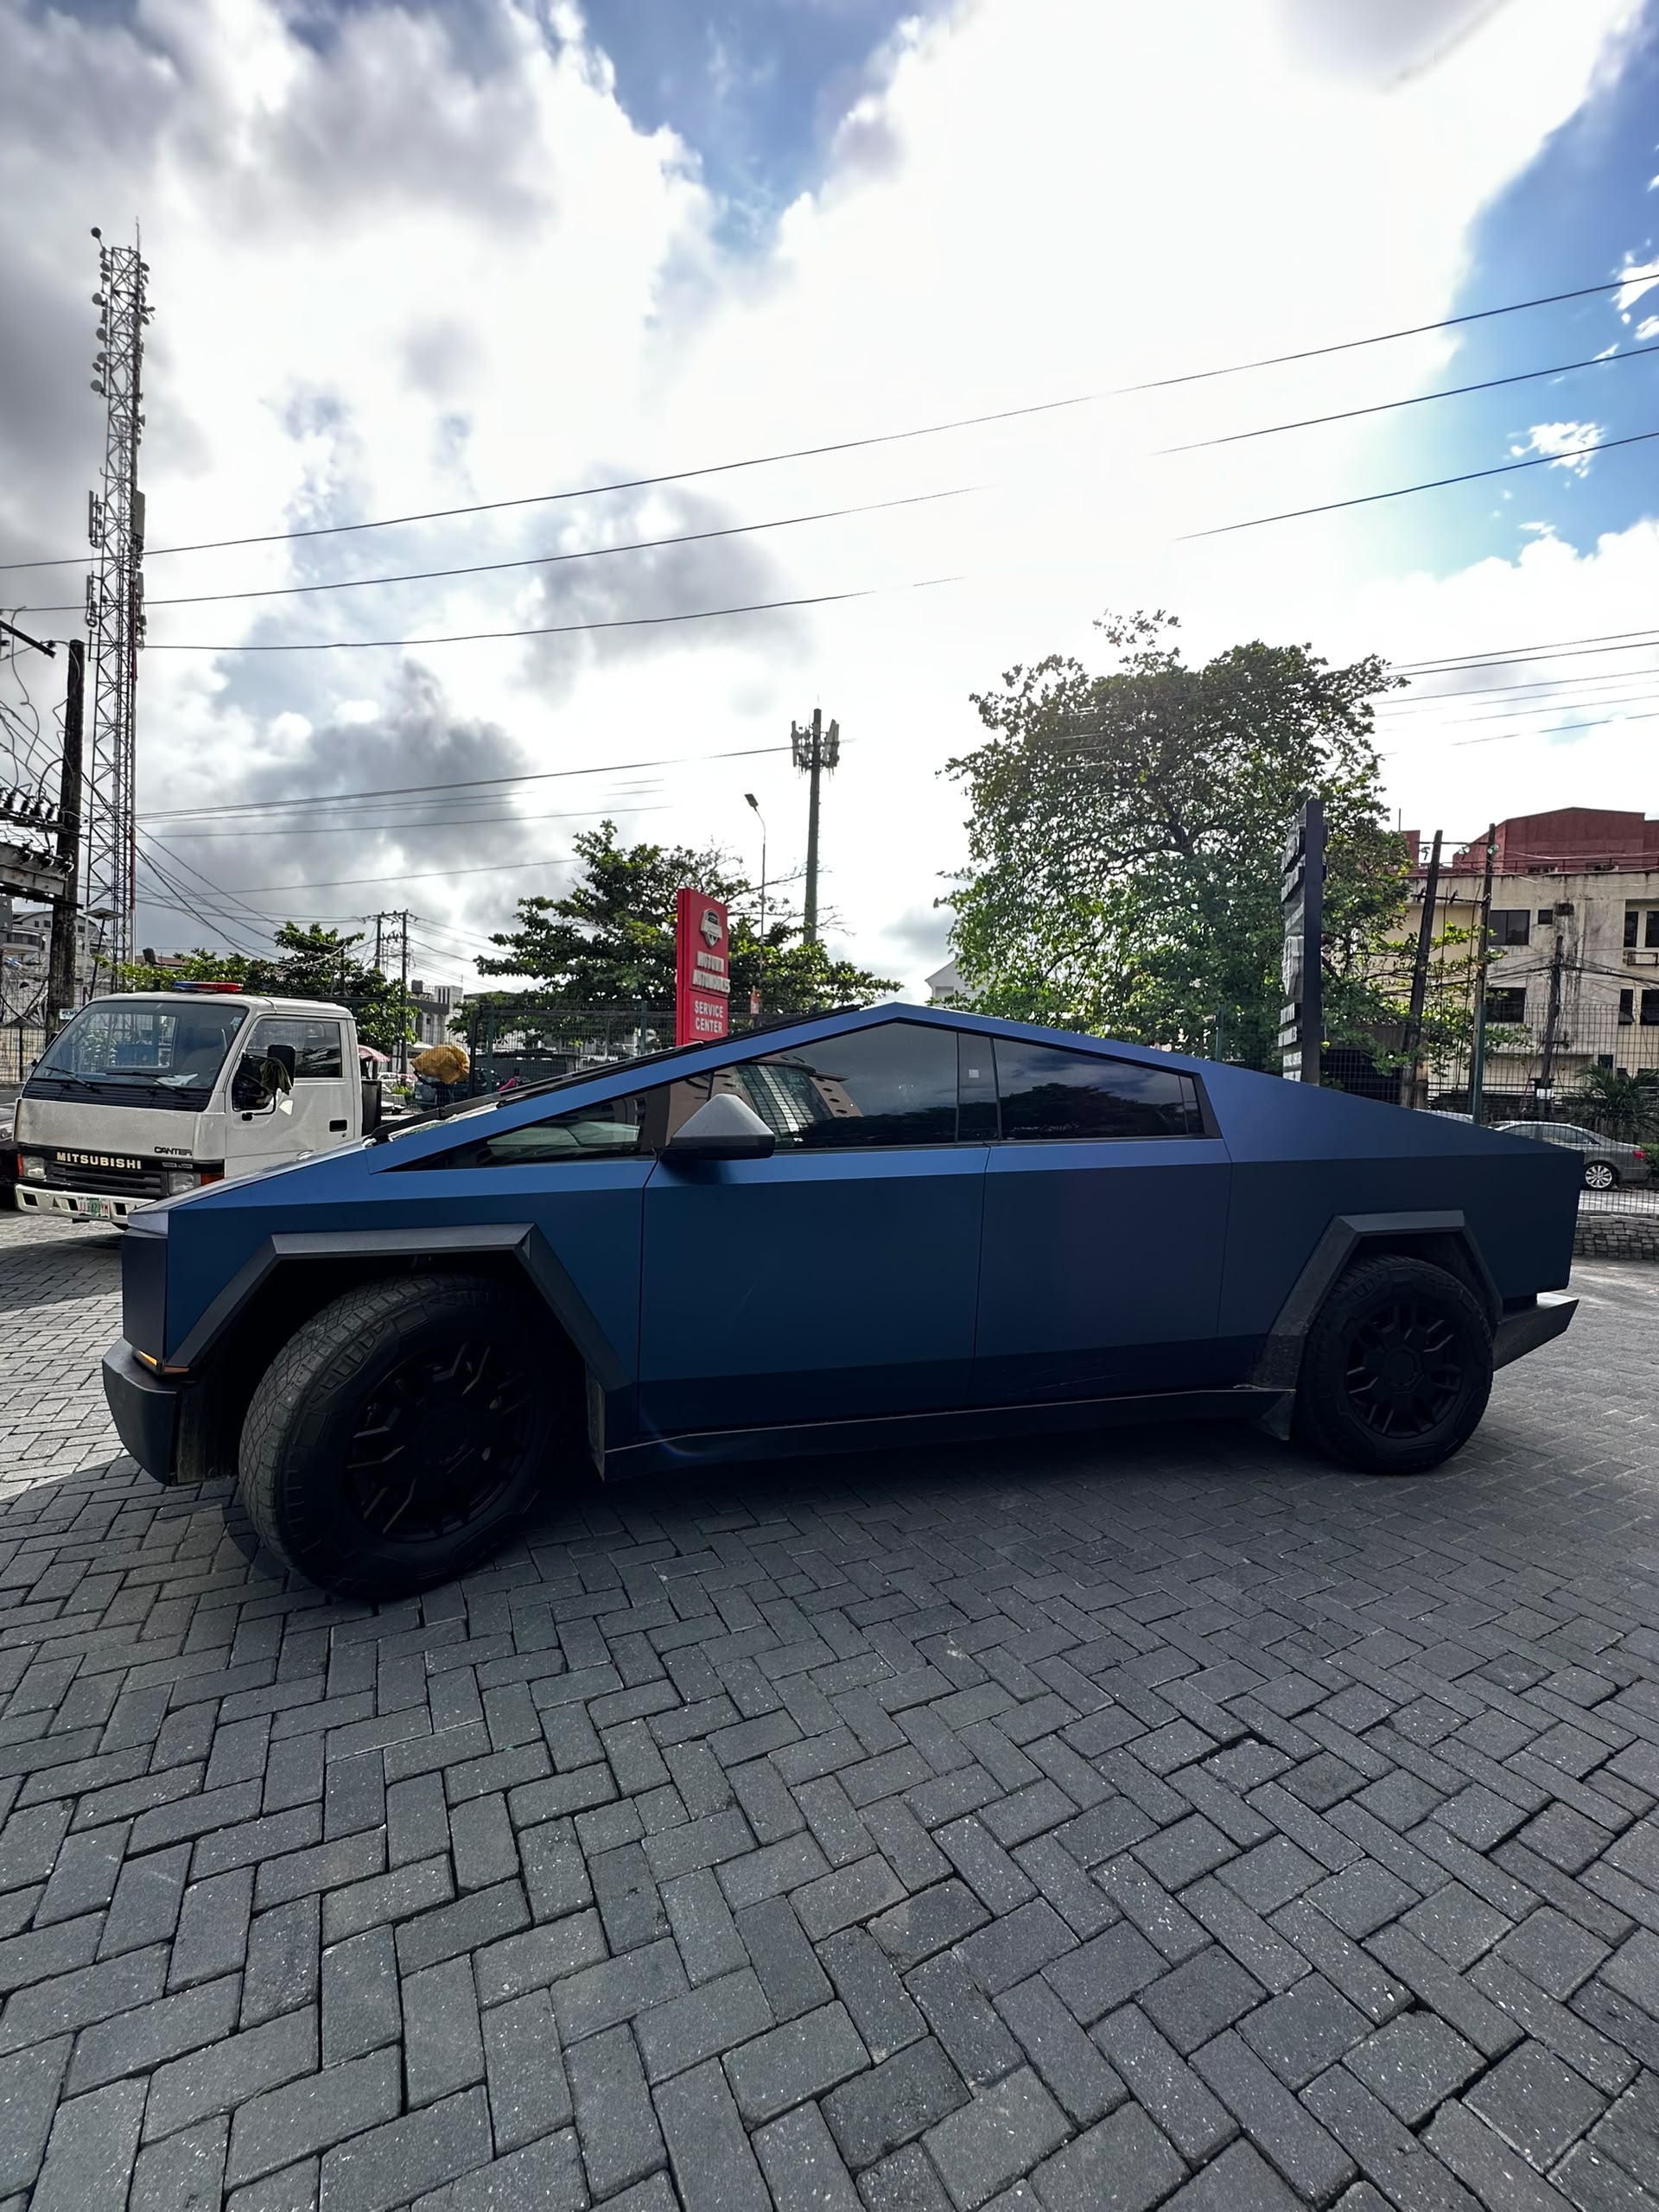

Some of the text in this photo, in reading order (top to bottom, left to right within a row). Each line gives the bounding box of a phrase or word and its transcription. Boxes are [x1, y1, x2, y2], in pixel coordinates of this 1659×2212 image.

[694, 1000, 723, 1018] SERVICE
[695, 1017, 722, 1033] CENTER
[154, 1146, 193, 1156] CANTER
[56, 1152, 142, 1169] MITSUBISHI
